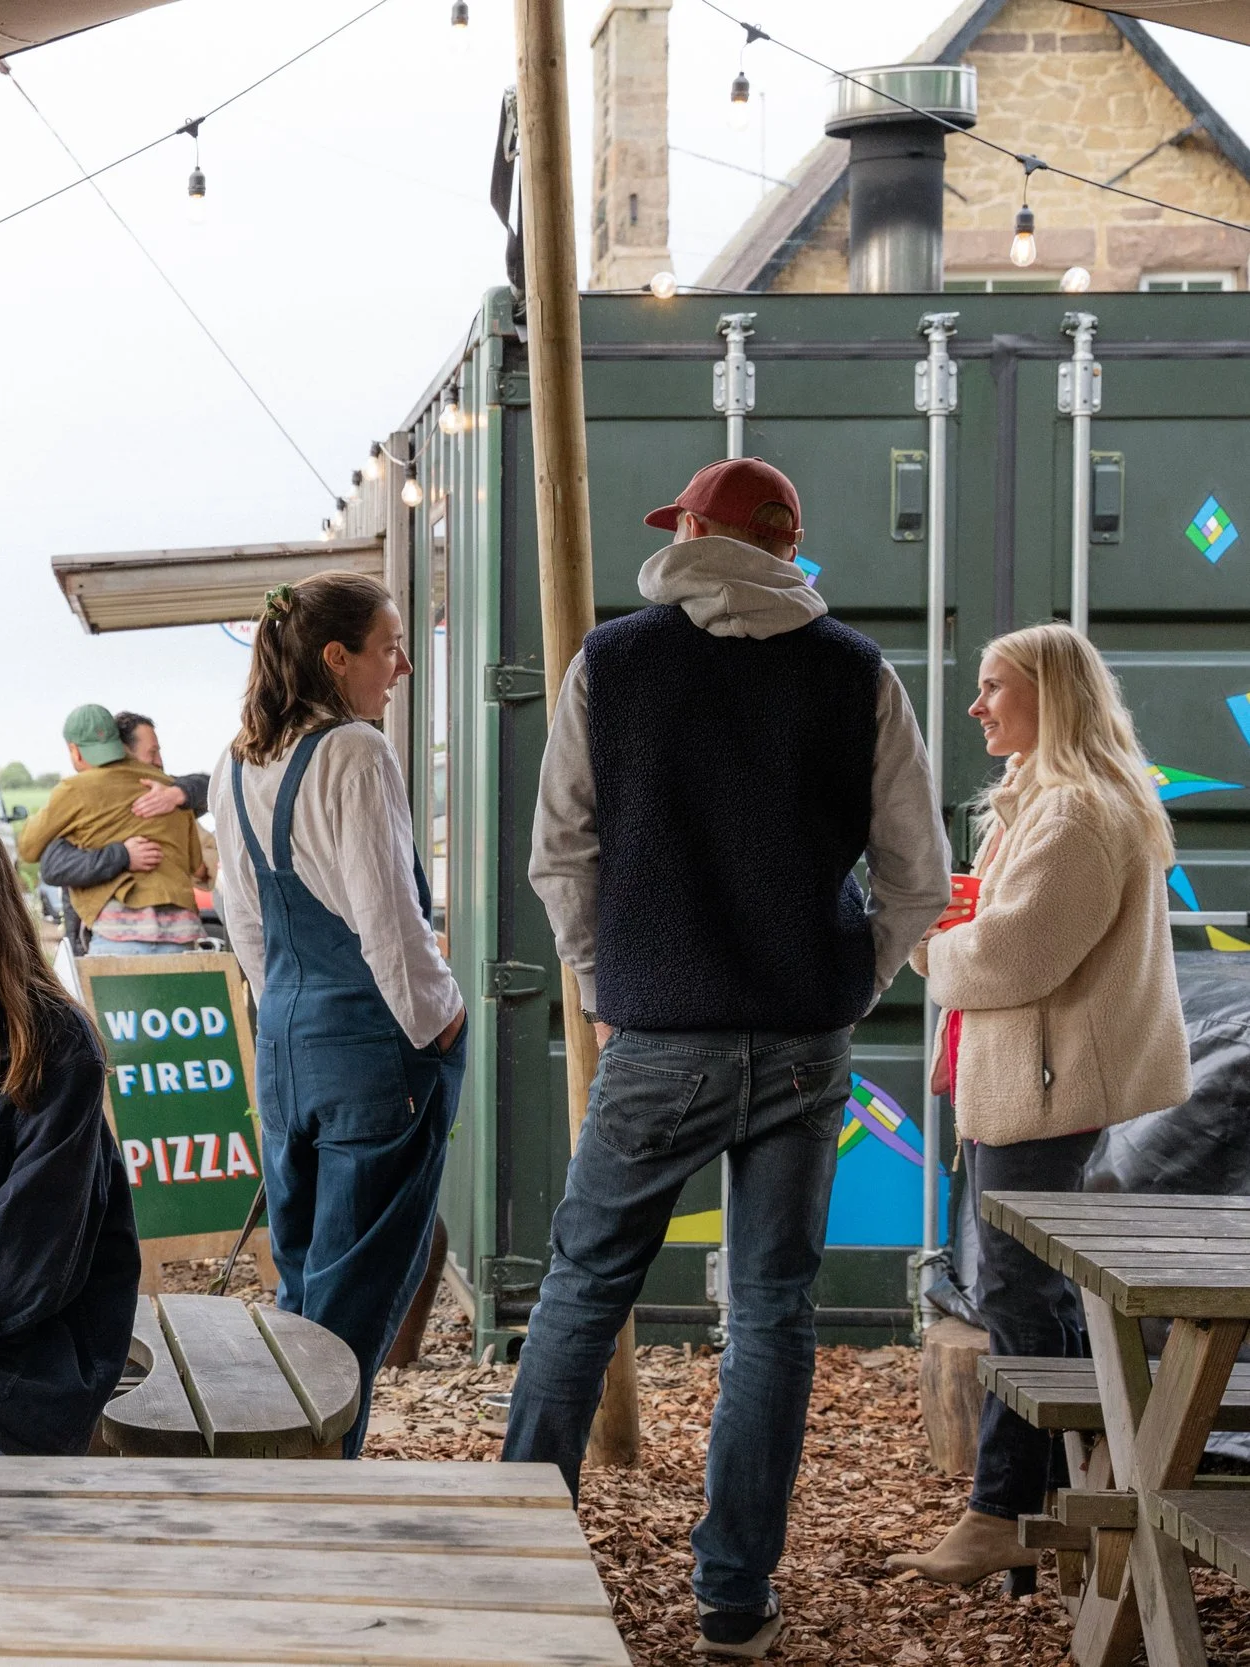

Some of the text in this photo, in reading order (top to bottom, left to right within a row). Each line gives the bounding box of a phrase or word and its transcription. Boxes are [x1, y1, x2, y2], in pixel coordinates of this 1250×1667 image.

[104, 1006, 227, 1041] WOOD
[116, 1059, 235, 1096] FIRED
[122, 1132, 259, 1187] PIZZA
